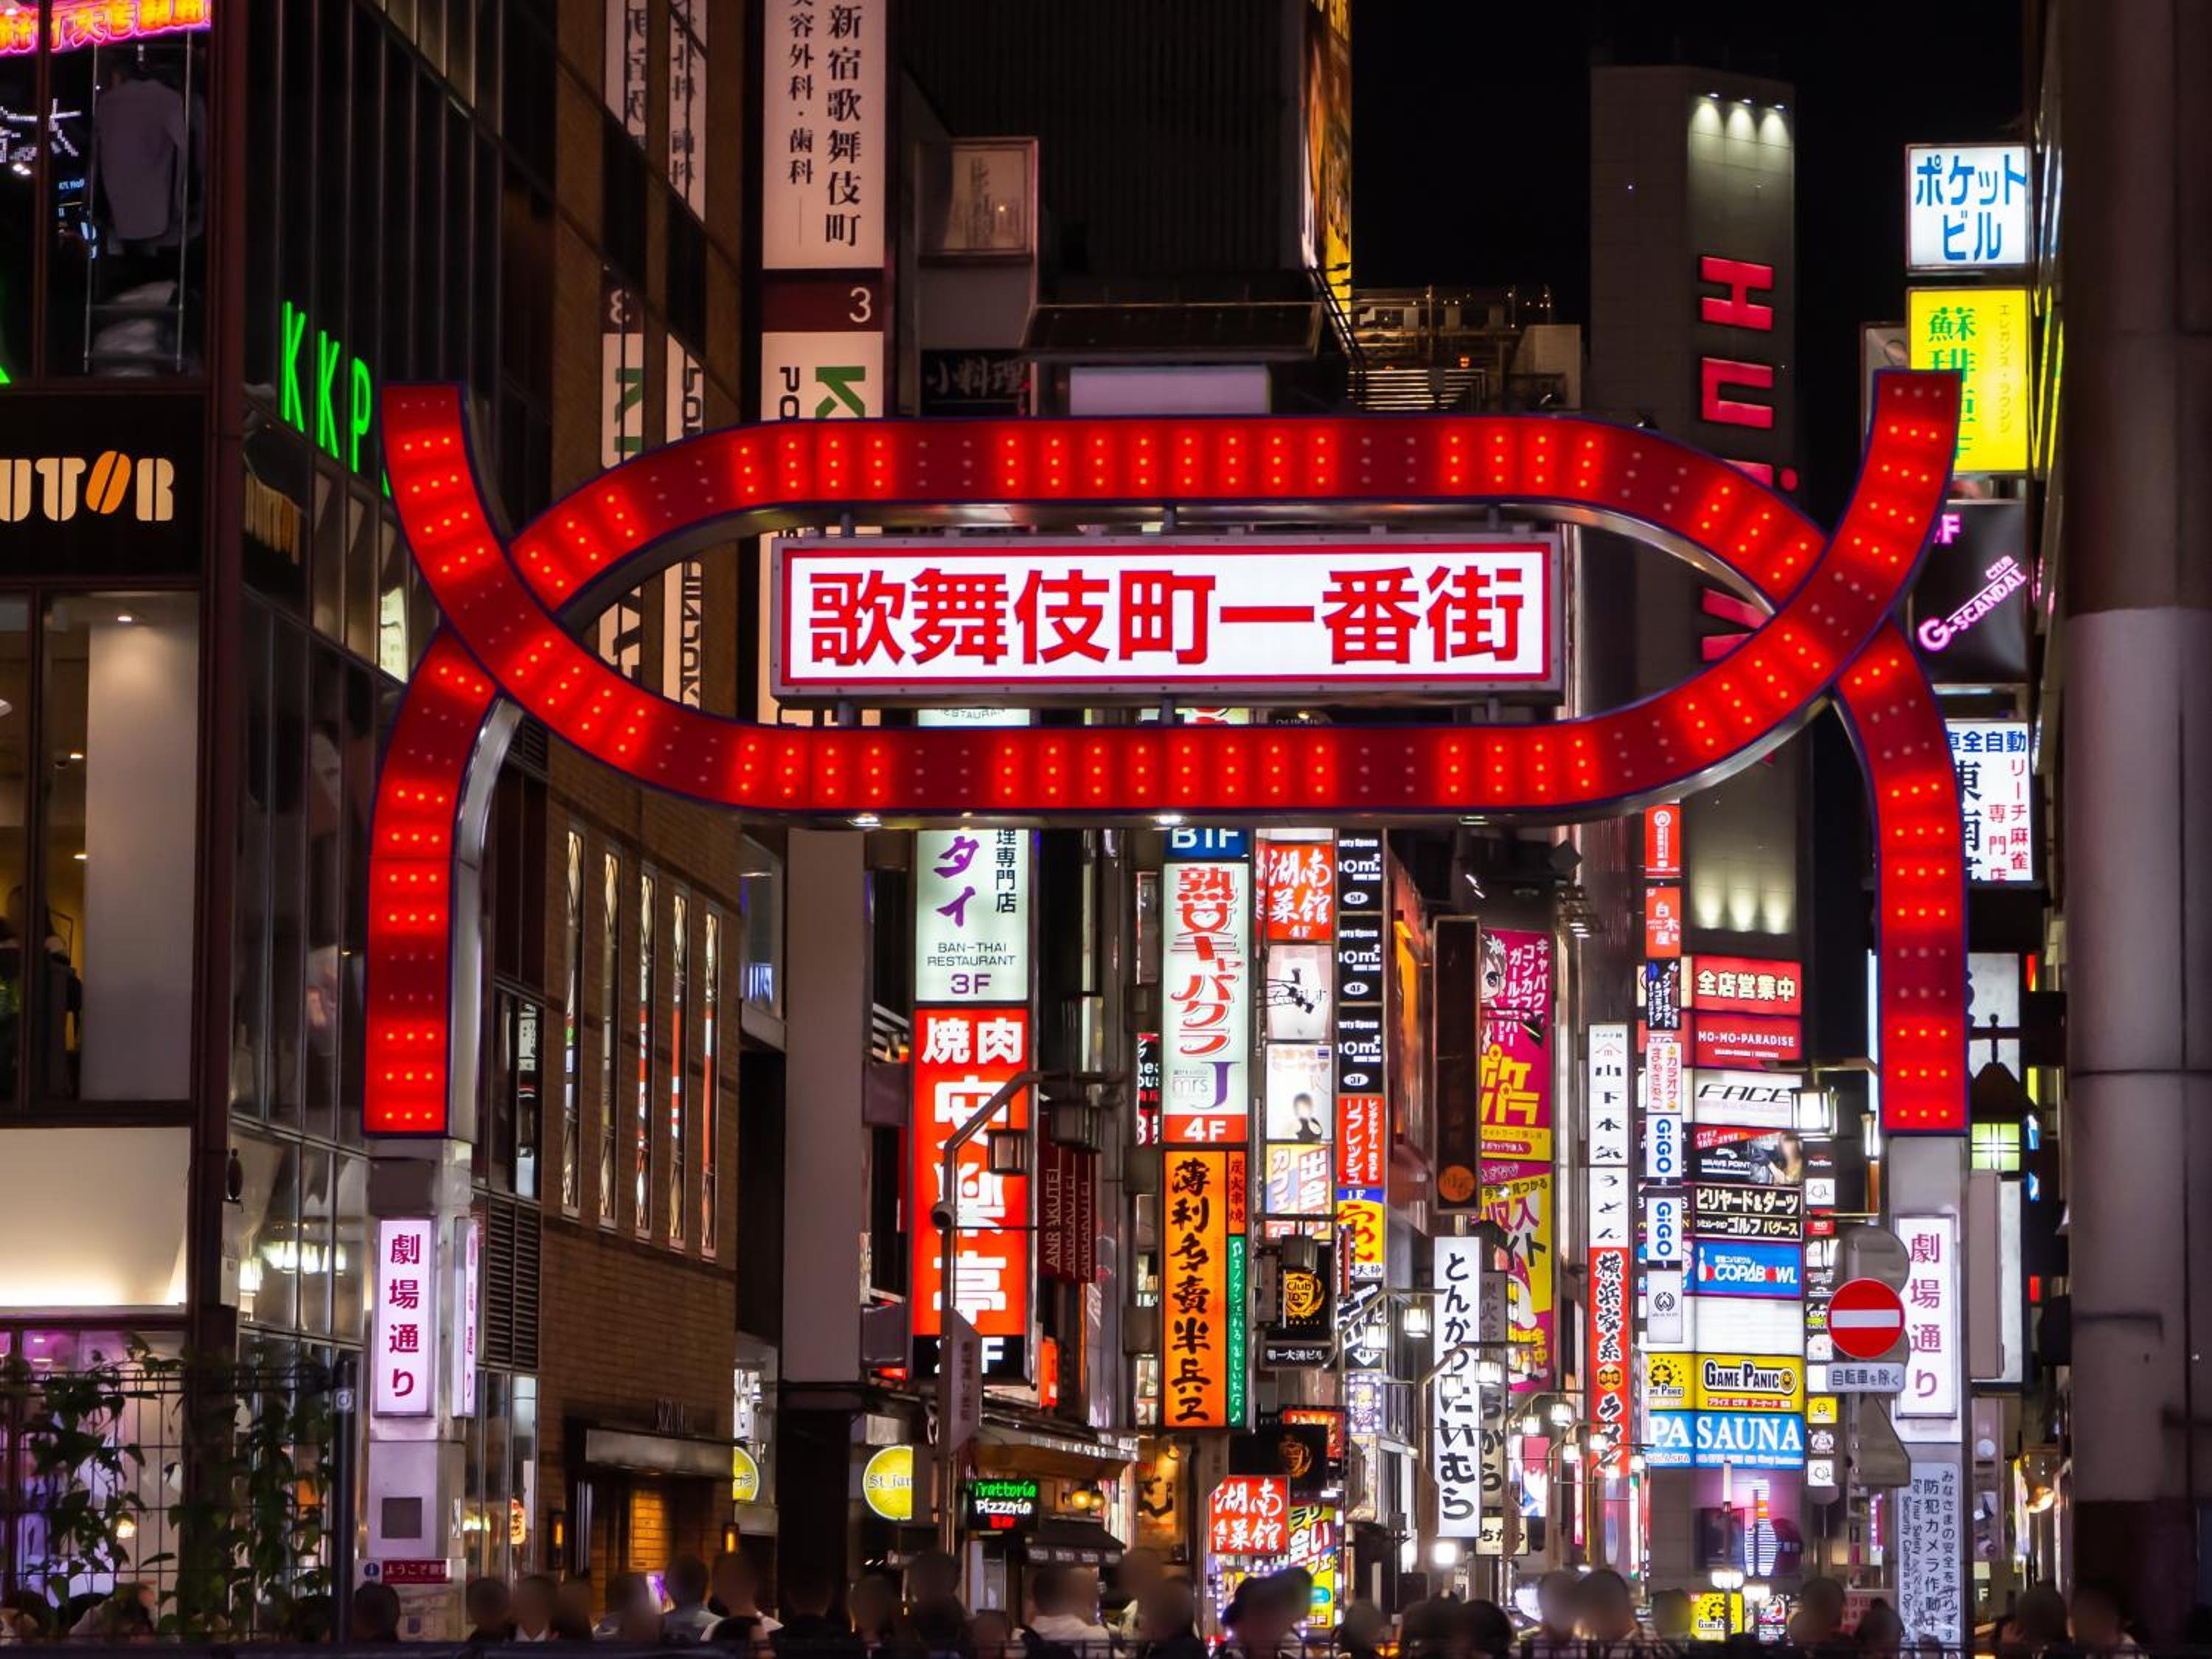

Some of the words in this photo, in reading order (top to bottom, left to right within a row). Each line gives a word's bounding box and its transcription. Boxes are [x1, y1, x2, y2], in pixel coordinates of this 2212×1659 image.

[789, 0, 814, 184] 容外科・歯科
[825, 4, 863, 247] 新宿歌舞伎町
[1916, 154, 2026, 206] ポケット
[1943, 211, 2001, 260] ビル
[849, 287, 872, 322] 3
[1986, 555, 2013, 580] CLUB
[809, 566, 1525, 666] 歌舞伎町一番街
[1918, 568, 2027, 651] G-SCANDAL
[2011, 759, 2028, 870] リーチ麻雀
[1989, 804, 2006, 882] 専門店
[933, 835, 980, 927] タイ
[1269, 849, 1332, 888] 湖南
[928, 956, 1015, 967] RESTAURANT
[938, 942, 1006, 953] BAN-THAI
[951, 974, 991, 994] 3F
[1697, 970, 1795, 1001] 全店営業中
[922, 1018, 1023, 1064] 焼肉
[1698, 1032, 1794, 1046] MO-MO-PARADISE
[1184, 1118, 1227, 1141] 4F
[1657, 1119, 1672, 1173] GiGO
[1697, 1189, 1798, 1214] ビリヤード&ダーツ
[1657, 1202, 1672, 1256] GiGO
[1728, 1217, 1761, 1234] ゴルフ
[1763, 1220, 1798, 1236] バグース
[1287, 1281, 1312, 1290] Club
[1715, 1261, 1798, 1283] COPABOWL
[389, 1234, 420, 1397] 劇場通り
[1910, 1234, 1941, 1398] 劇場通り
[1705, 1362, 1739, 1387] GAME
[1742, 1363, 1779, 1390] PANIC
[1832, 1371, 1900, 1387] 自転車を除く
[1697, 1416, 1803, 1451] SAUNA
[1215, 1479, 1282, 1517] 湖南
[1924, 1479, 1940, 1631] 防犯カメラ作動中
